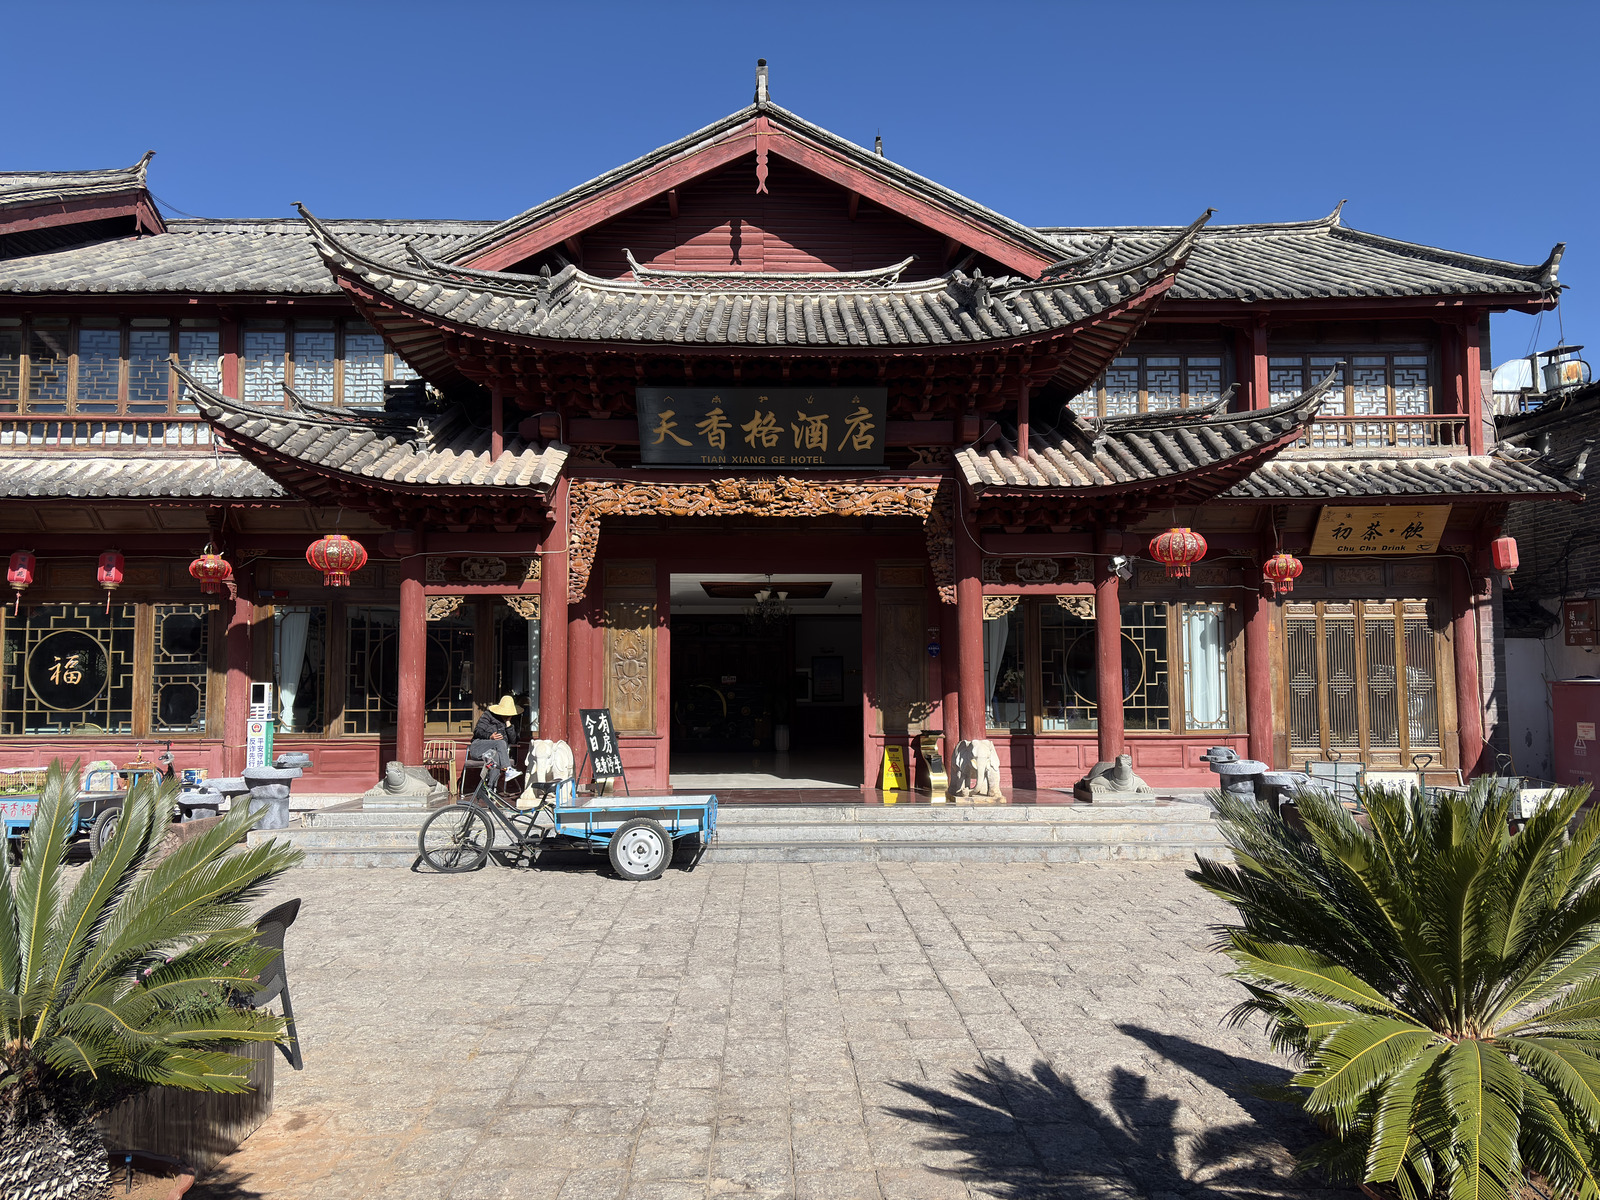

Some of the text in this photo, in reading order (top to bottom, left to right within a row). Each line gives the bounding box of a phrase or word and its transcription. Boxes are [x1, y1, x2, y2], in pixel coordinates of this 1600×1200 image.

[651, 406, 876, 452] 天香格酒店
[701, 455, 825, 464] TIAN XIANG GE HOTEL
[48, 654, 82, 685] 福
[585, 714, 599, 752] 今日
[598, 712, 613, 754] 有房
